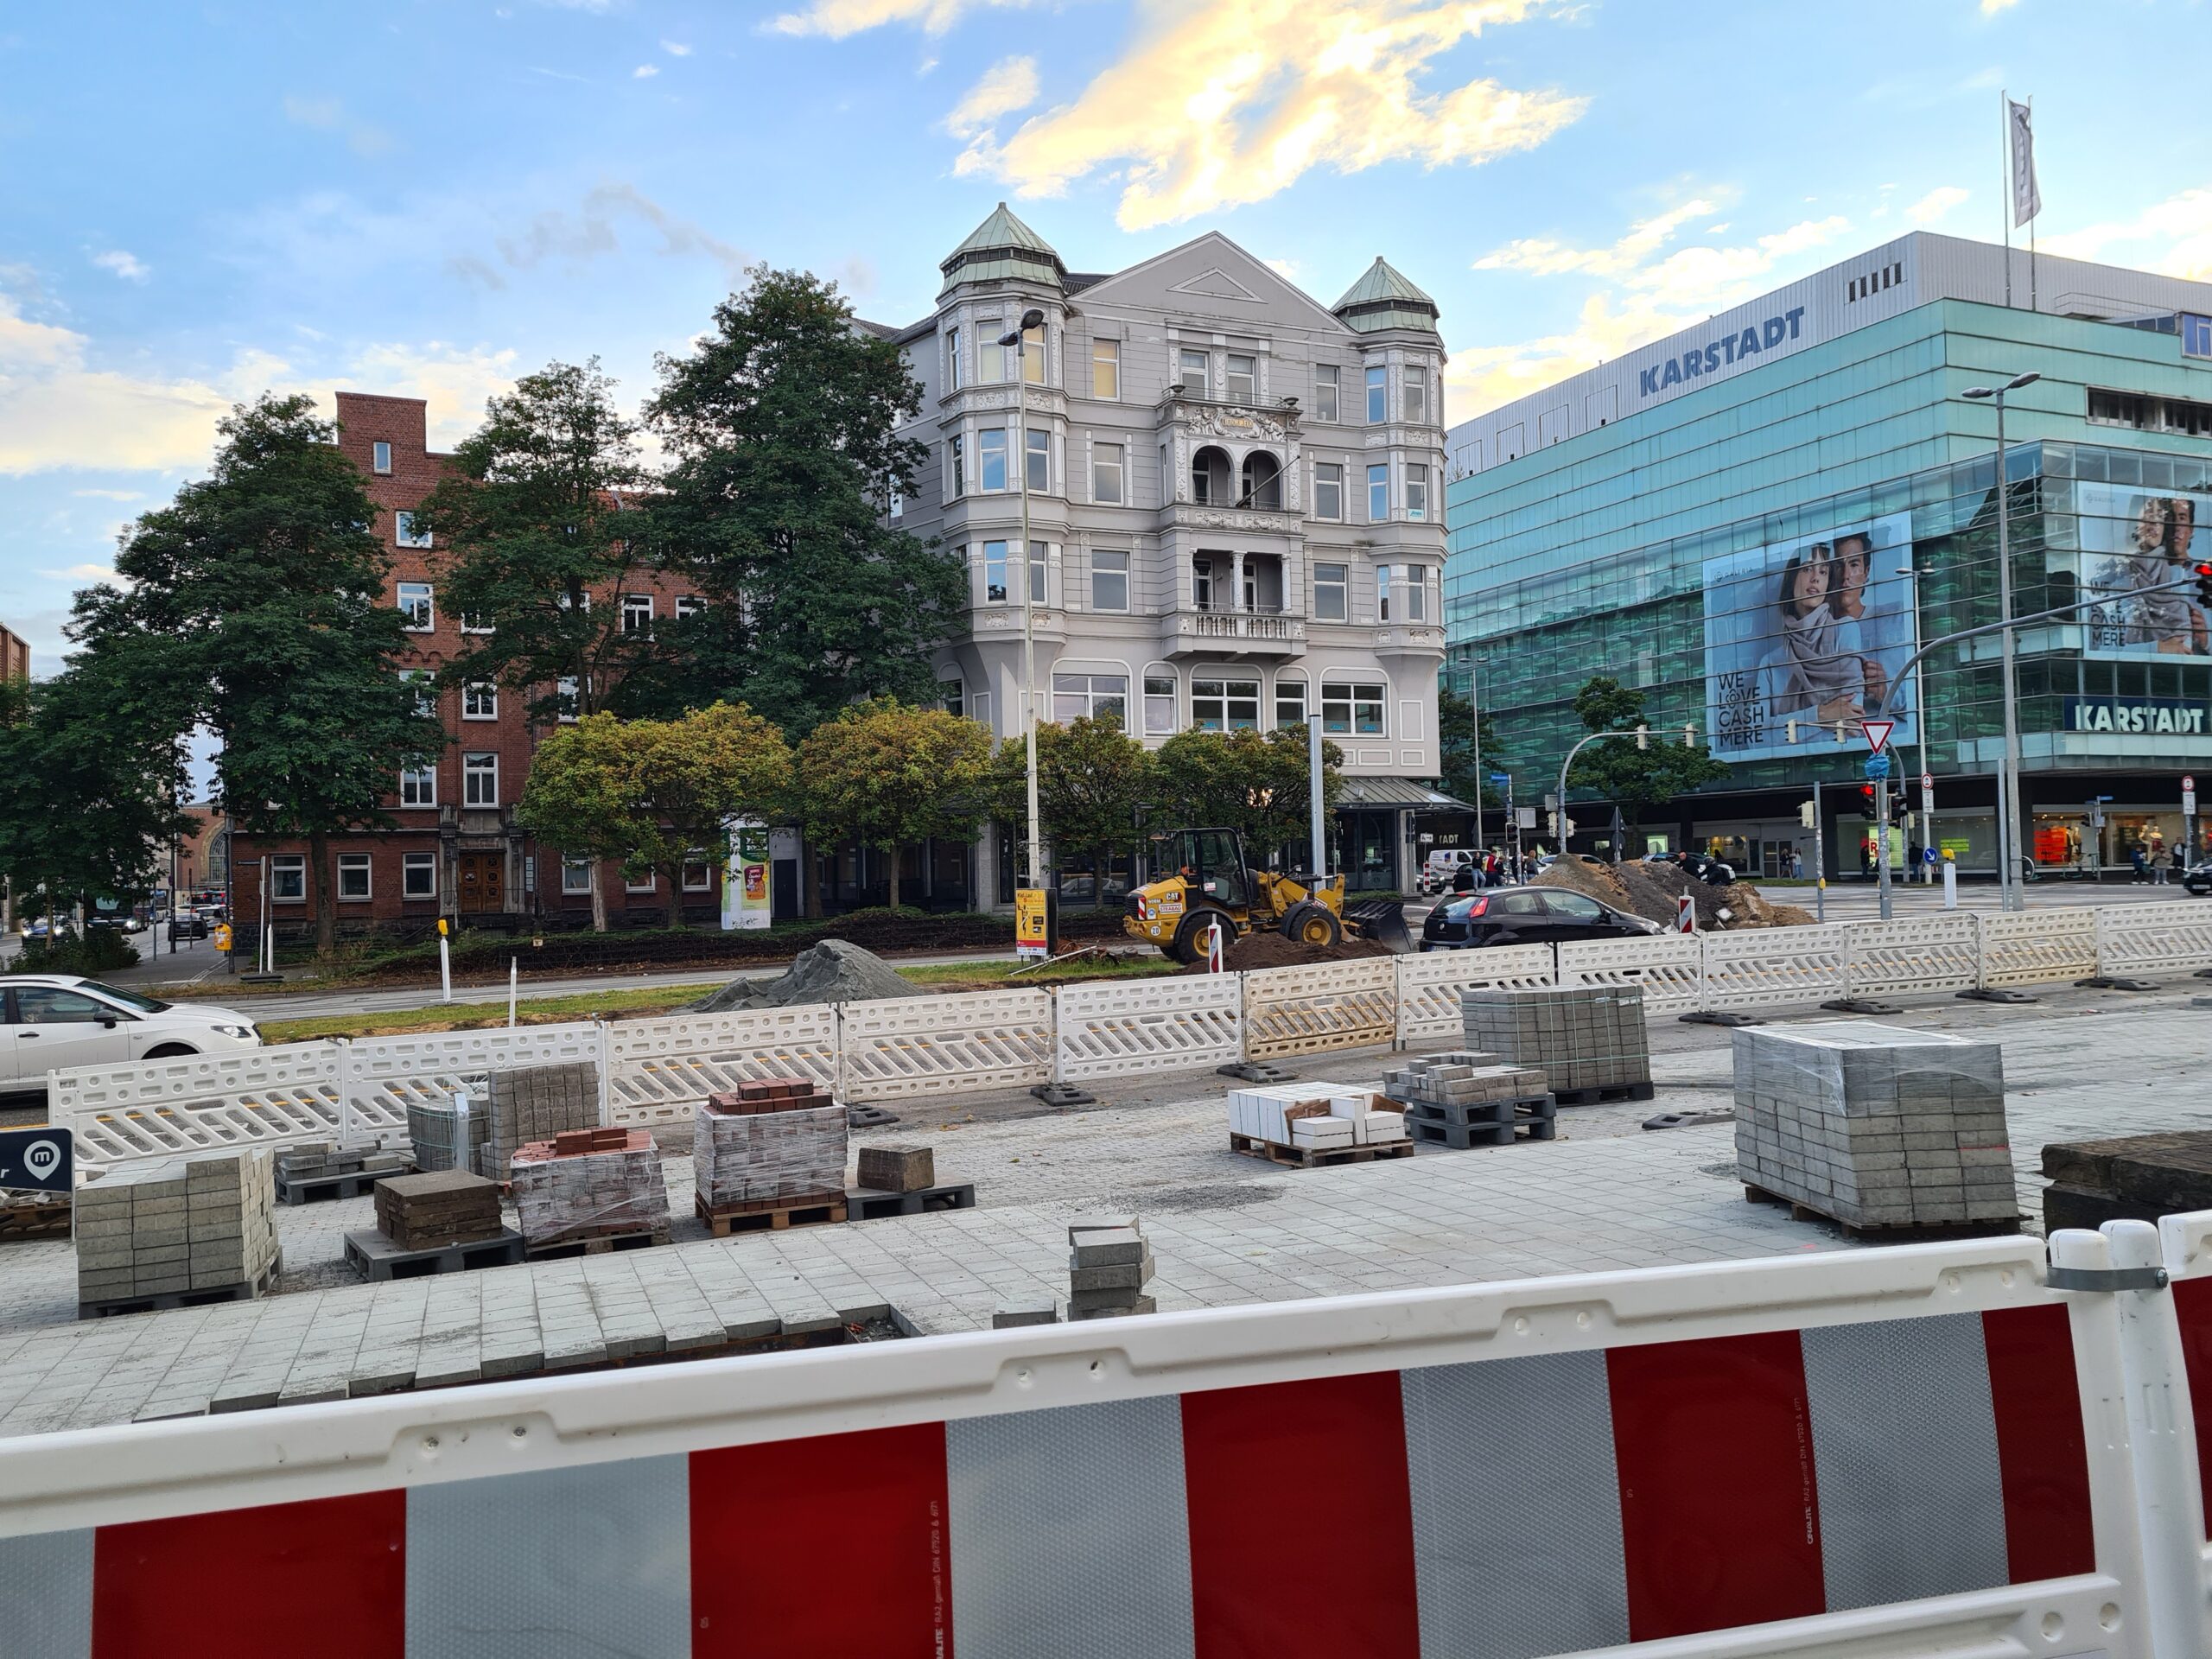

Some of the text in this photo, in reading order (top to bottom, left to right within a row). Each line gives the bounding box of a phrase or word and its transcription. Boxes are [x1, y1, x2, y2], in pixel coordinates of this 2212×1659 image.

[1640, 306, 1805, 397] KARSTADT
[2091, 614, 2126, 630] CASH
[2093, 632, 2126, 646] MERE
[1719, 672, 1744, 690] WE
[1719, 706, 1764, 727] CASH
[2075, 705, 2203, 733] KARSTADT
[1719, 725, 1764, 747] MERE
[1805, 1506, 1814, 1545] ORALITE
